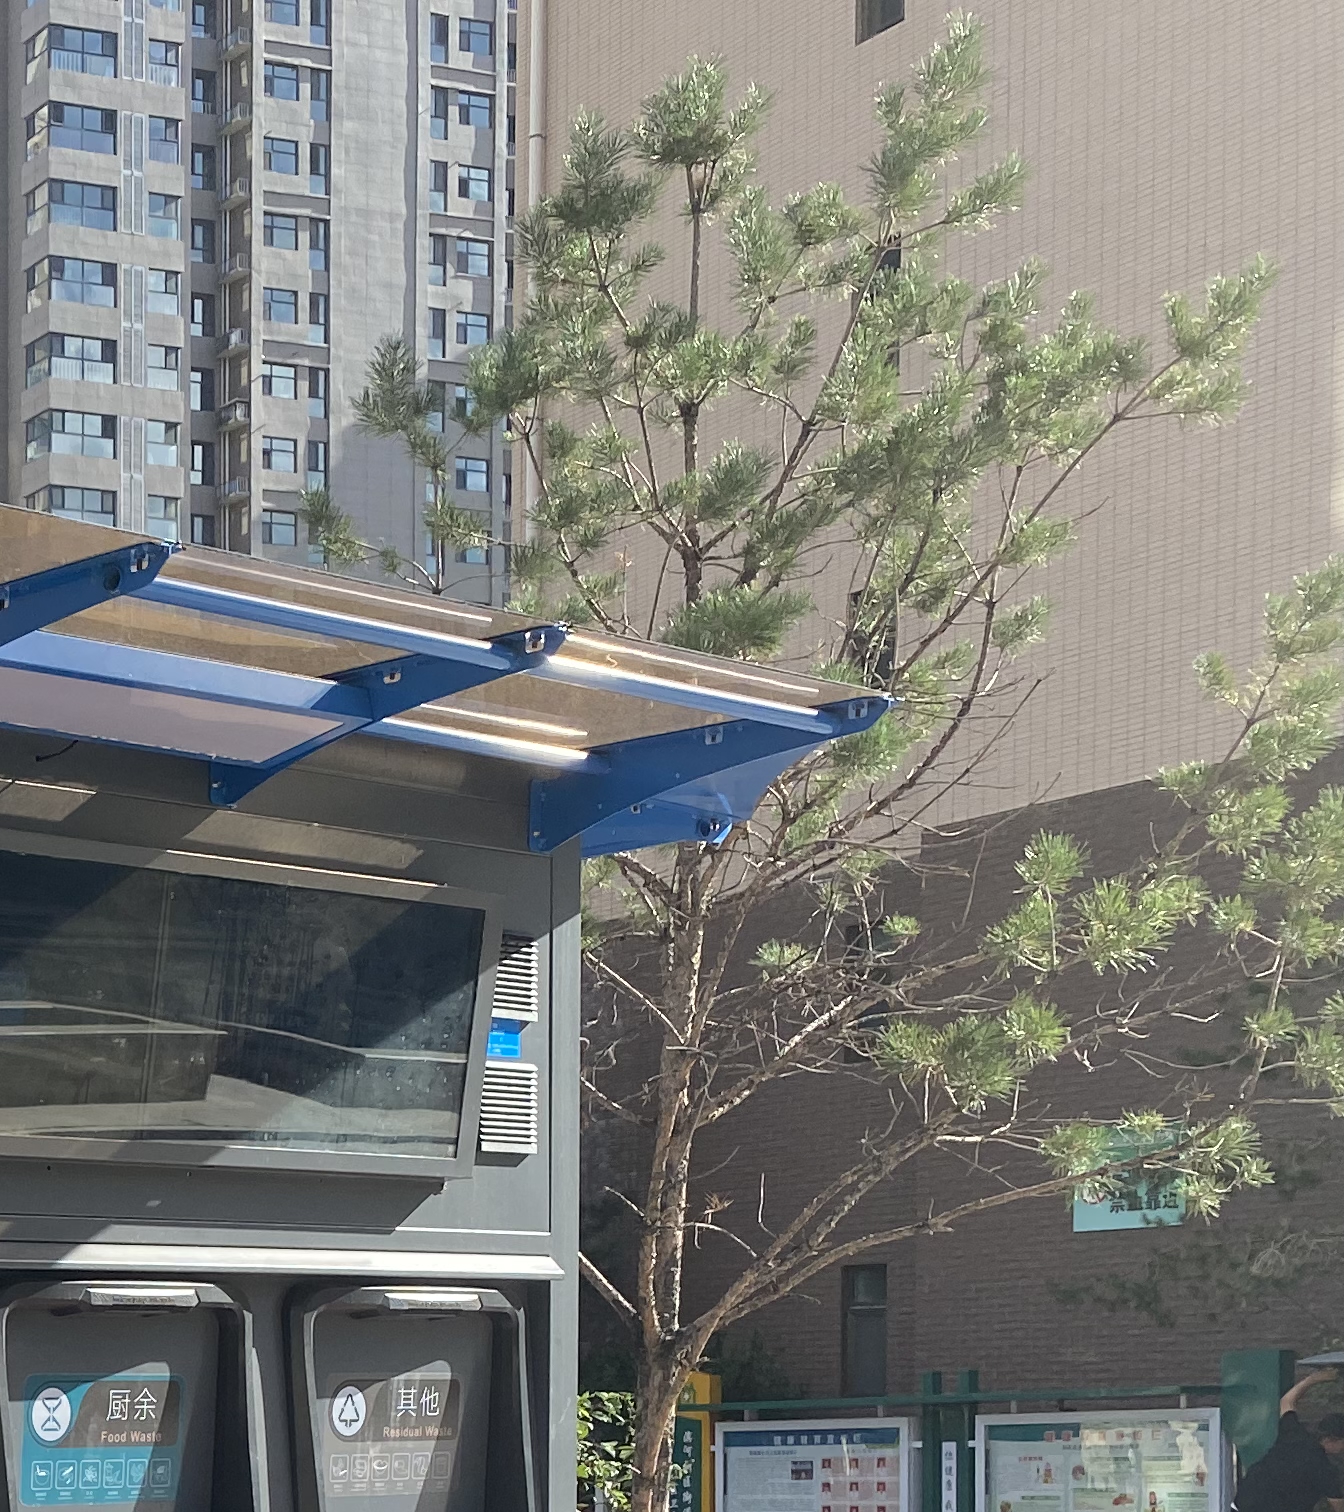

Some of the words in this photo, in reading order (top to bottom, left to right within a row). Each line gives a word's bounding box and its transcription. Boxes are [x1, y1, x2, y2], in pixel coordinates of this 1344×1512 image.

[105, 1387, 158, 1421] 厨余
[396, 1385, 440, 1417] 其他
[101, 1430, 127, 1443] Food
[383, 1426, 423, 1438] Residual
